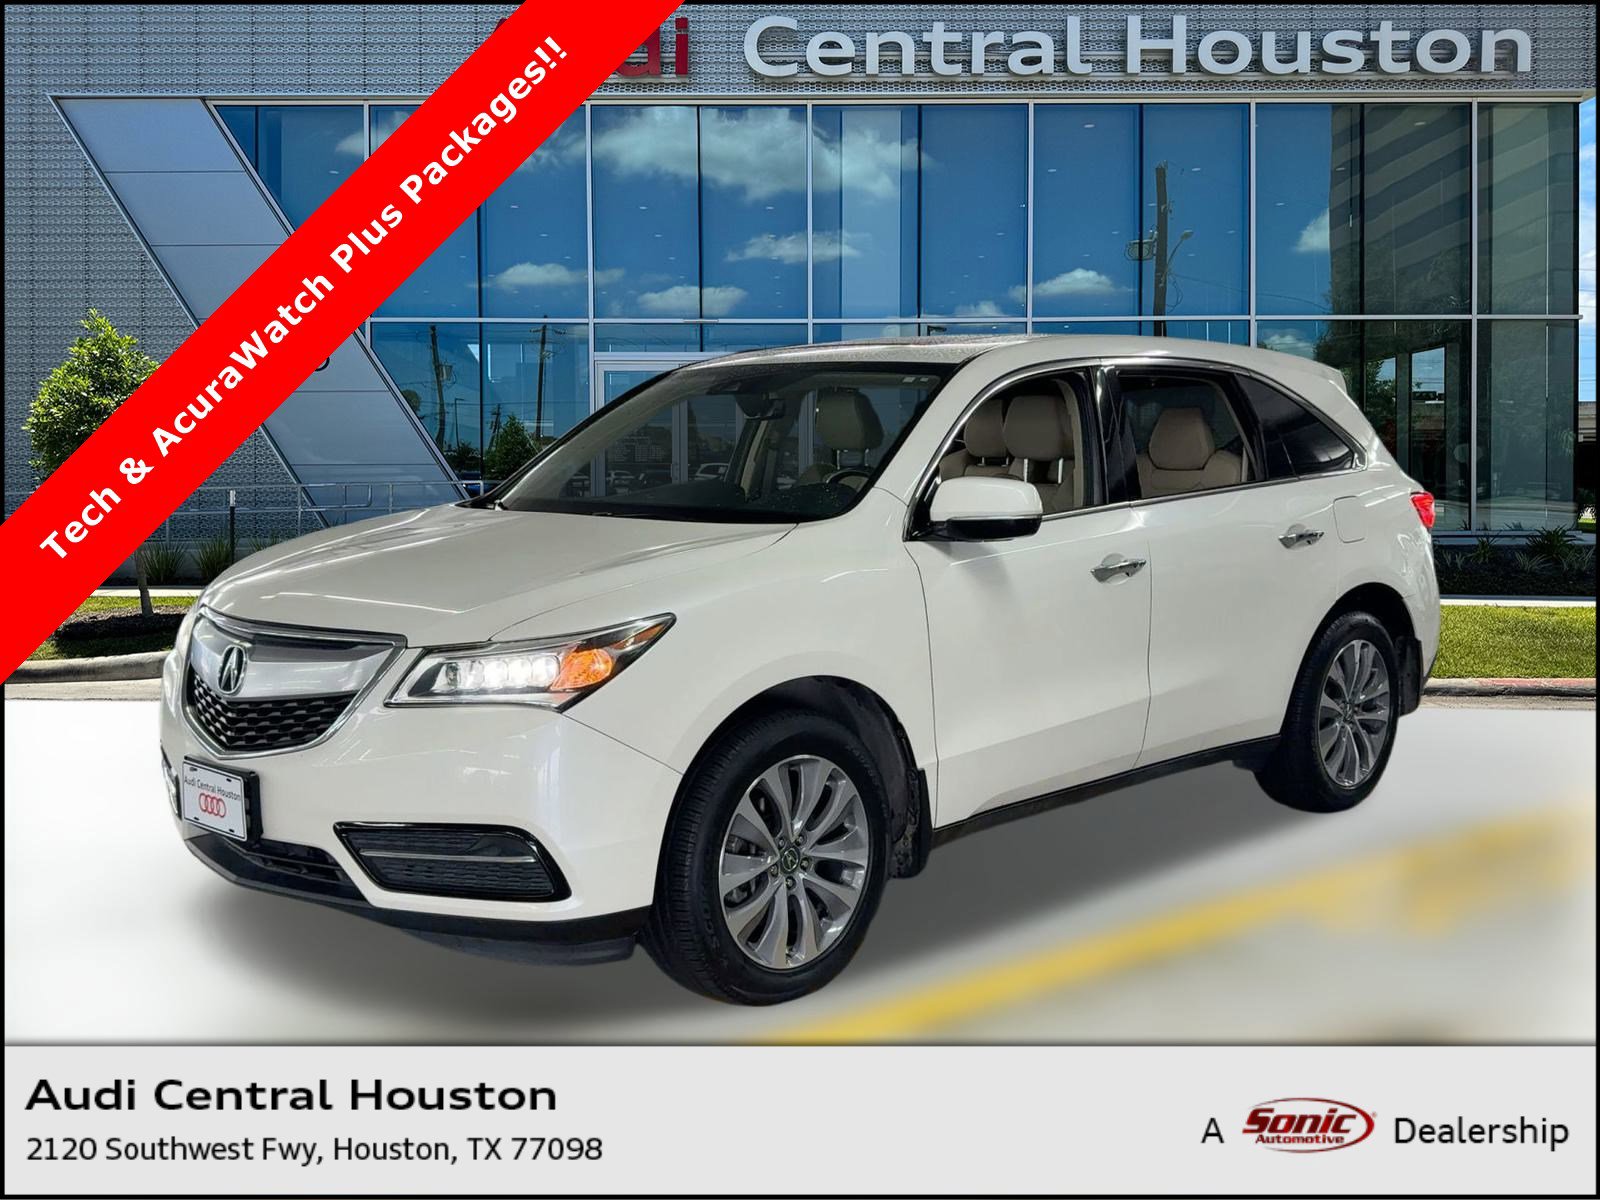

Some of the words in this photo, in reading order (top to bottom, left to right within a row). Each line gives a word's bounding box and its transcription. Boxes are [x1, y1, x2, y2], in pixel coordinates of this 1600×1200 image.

[744, 15, 1093, 77] Central
[1126, 15, 1532, 76] Houston
[197, 779, 217, 793] Central
